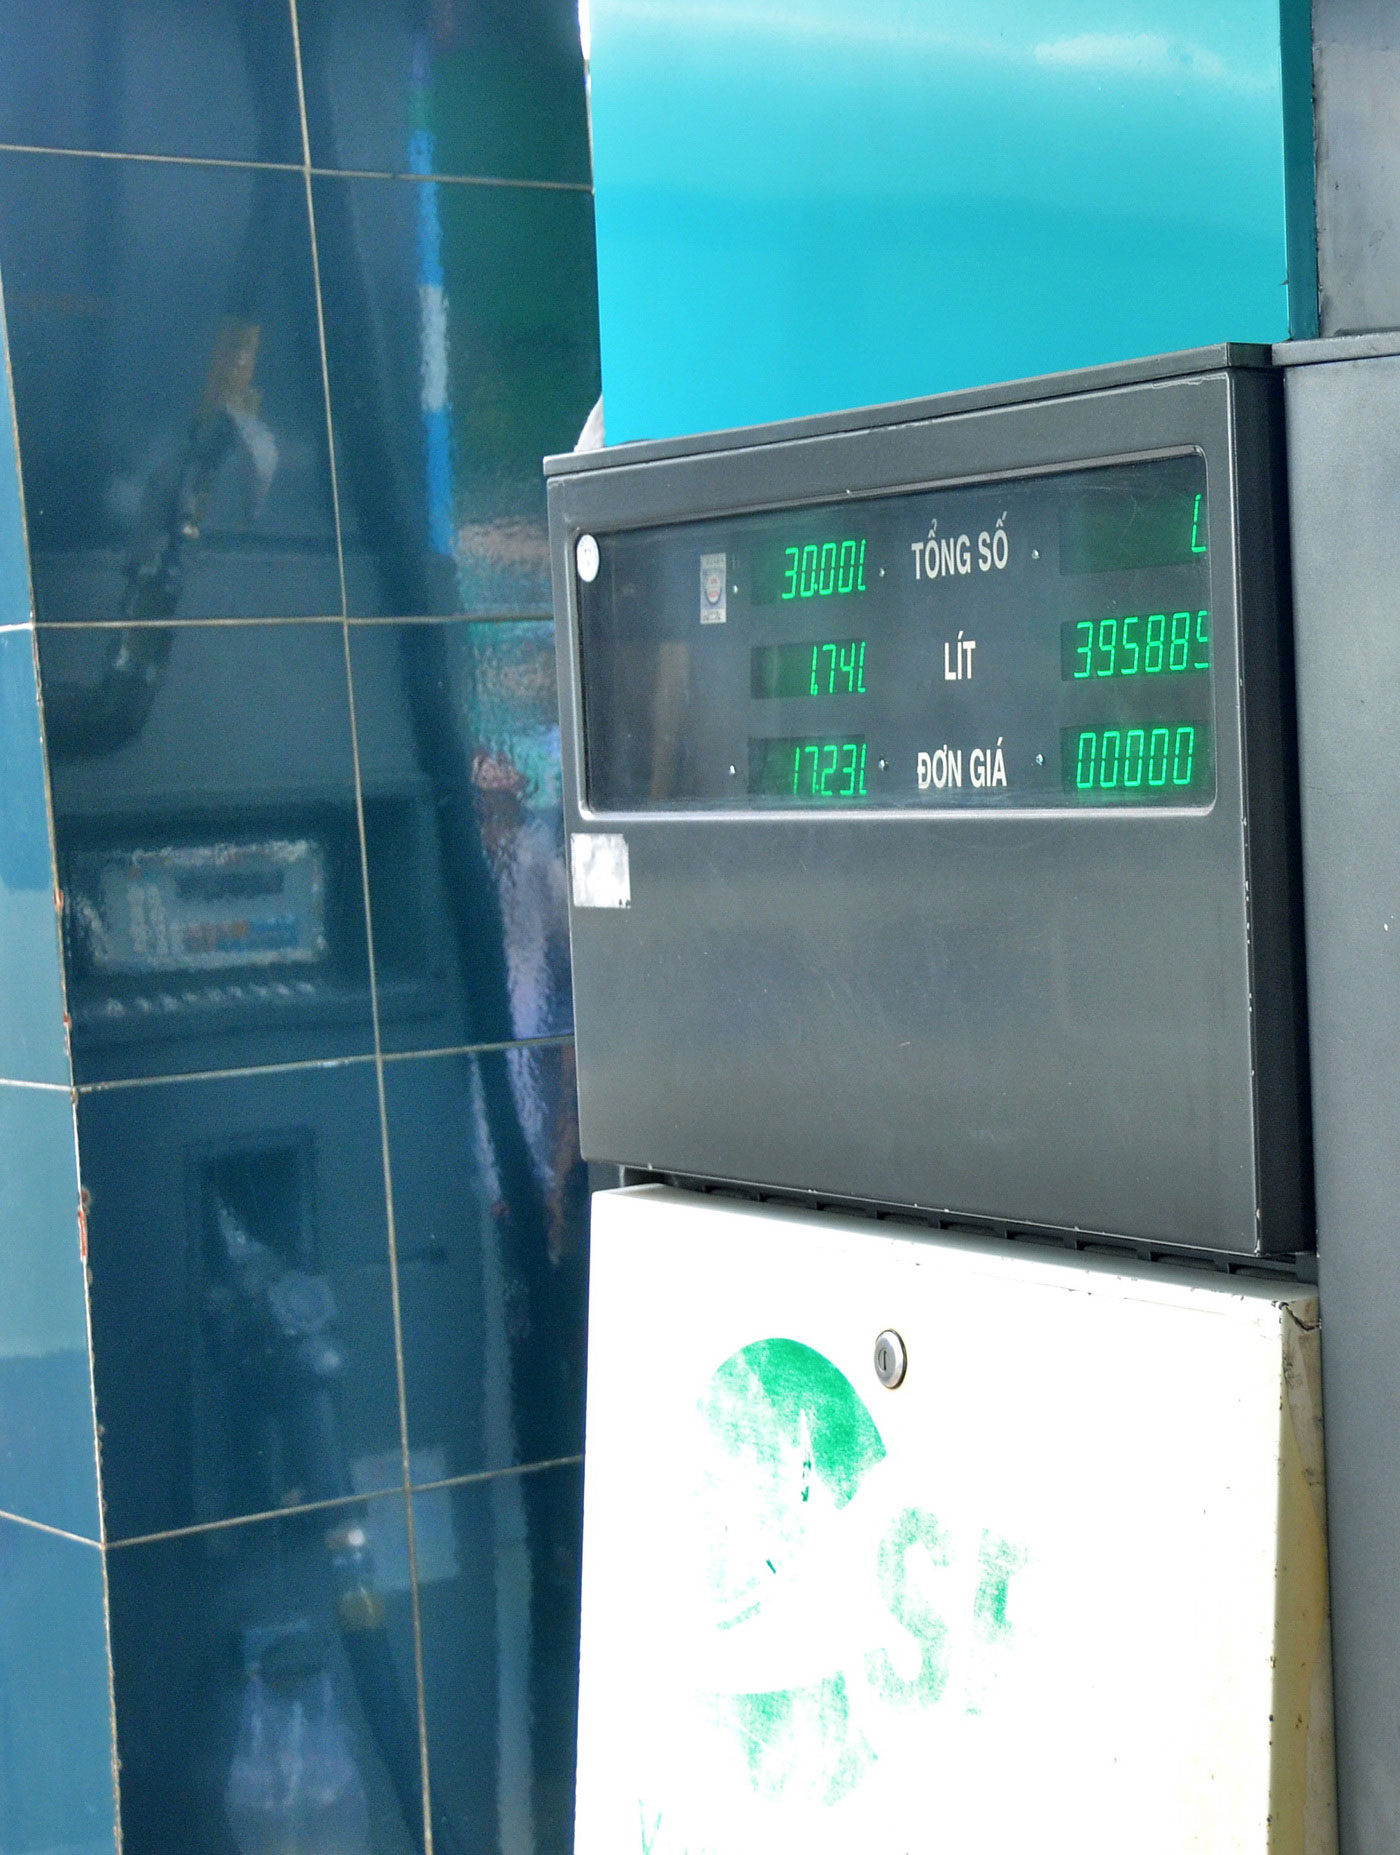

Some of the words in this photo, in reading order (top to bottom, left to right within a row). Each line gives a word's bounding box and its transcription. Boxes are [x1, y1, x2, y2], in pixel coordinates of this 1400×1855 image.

[911, 518, 971, 580] TỔNG
[978, 511, 1009, 572] SỐ
[944, 630, 976, 680] LÍT
[917, 744, 962, 789] ĐƠN
[969, 736, 1007, 789] GIÁ
[1076, 727, 1195, 789] 00000
